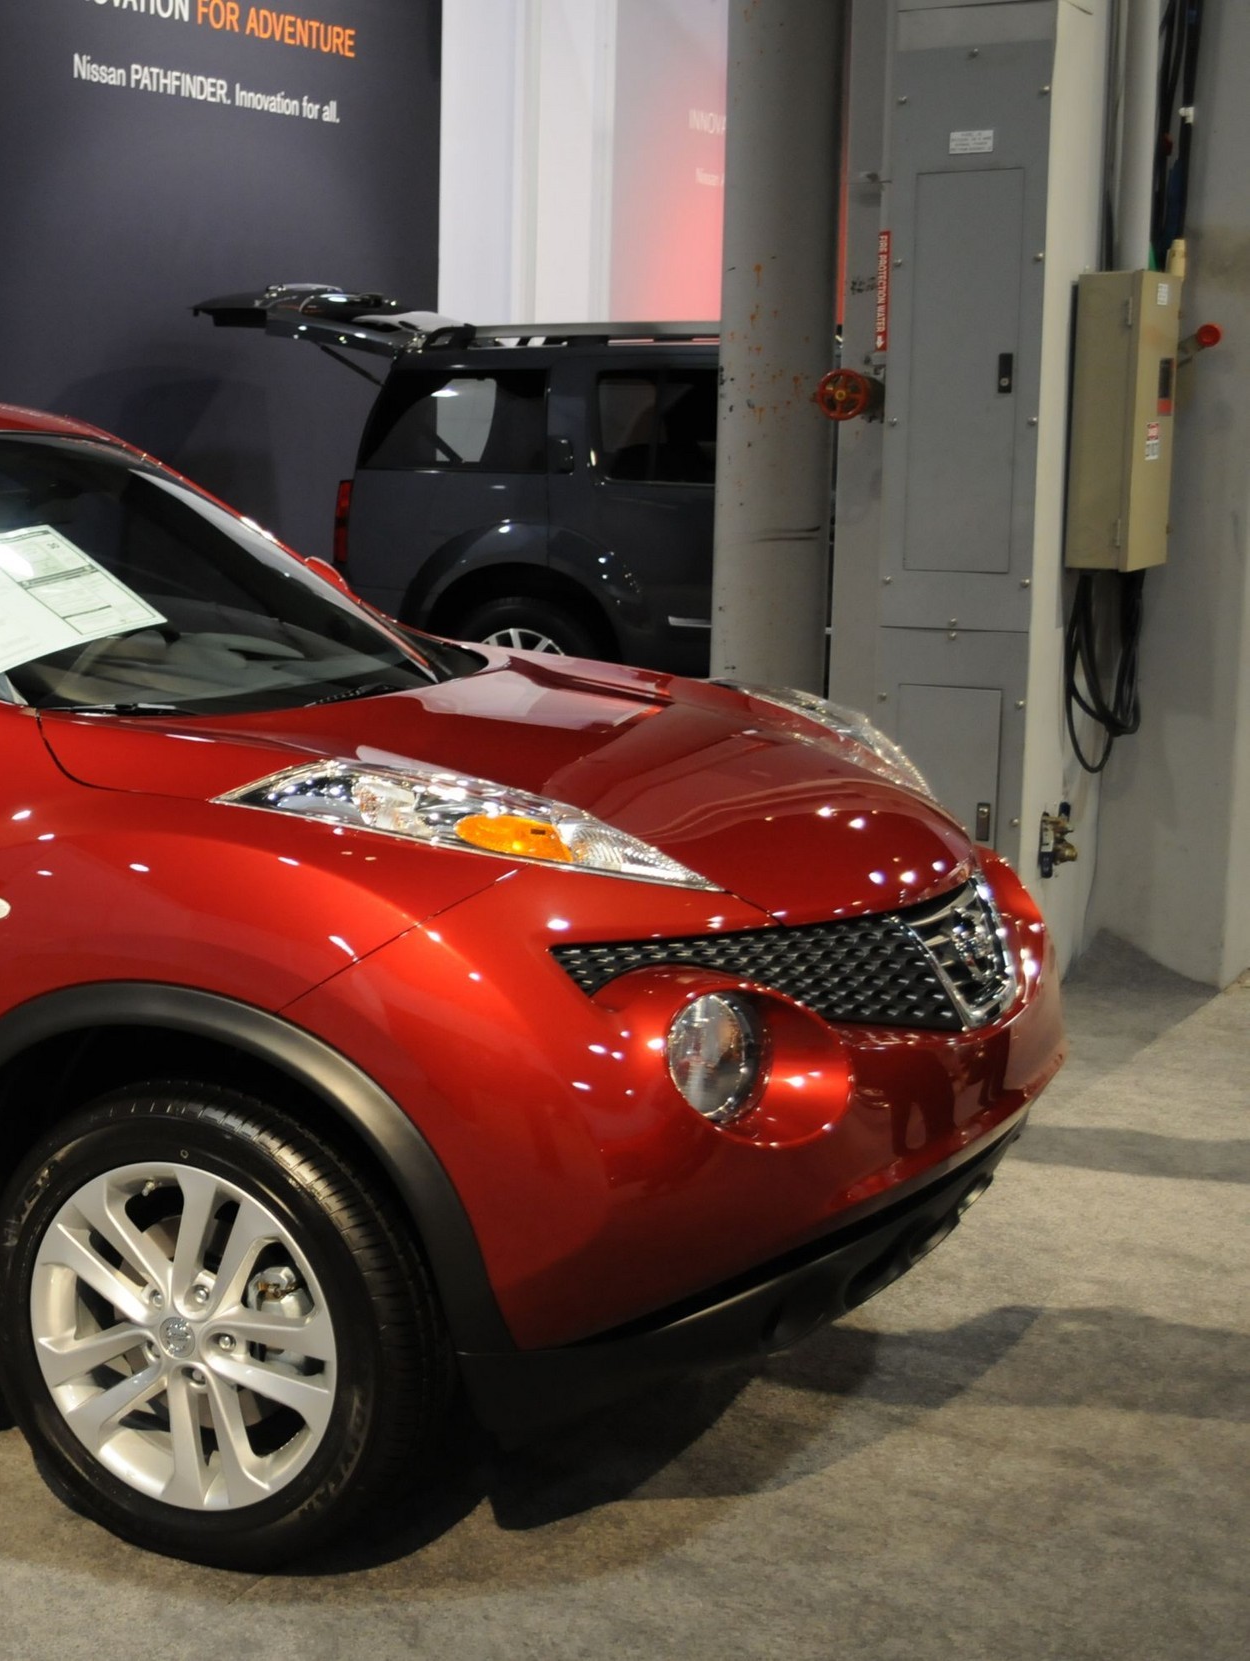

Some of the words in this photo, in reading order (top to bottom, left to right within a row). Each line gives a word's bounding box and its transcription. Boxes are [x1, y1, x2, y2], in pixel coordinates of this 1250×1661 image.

[197, 0, 239, 32] FOR
[246, 8, 356, 58] ADVENTURE
[73, 54, 126, 87] Nissan
[130, 64, 231, 104] PATHFINDER.
[235, 83, 299, 116] Innovation
[302, 96, 320, 120] for
[322, 101, 341, 124] all.
[878, 235, 888, 253] FIRE
[877, 254, 887, 304] PROTECTION
[876, 305, 886, 333] WATER
